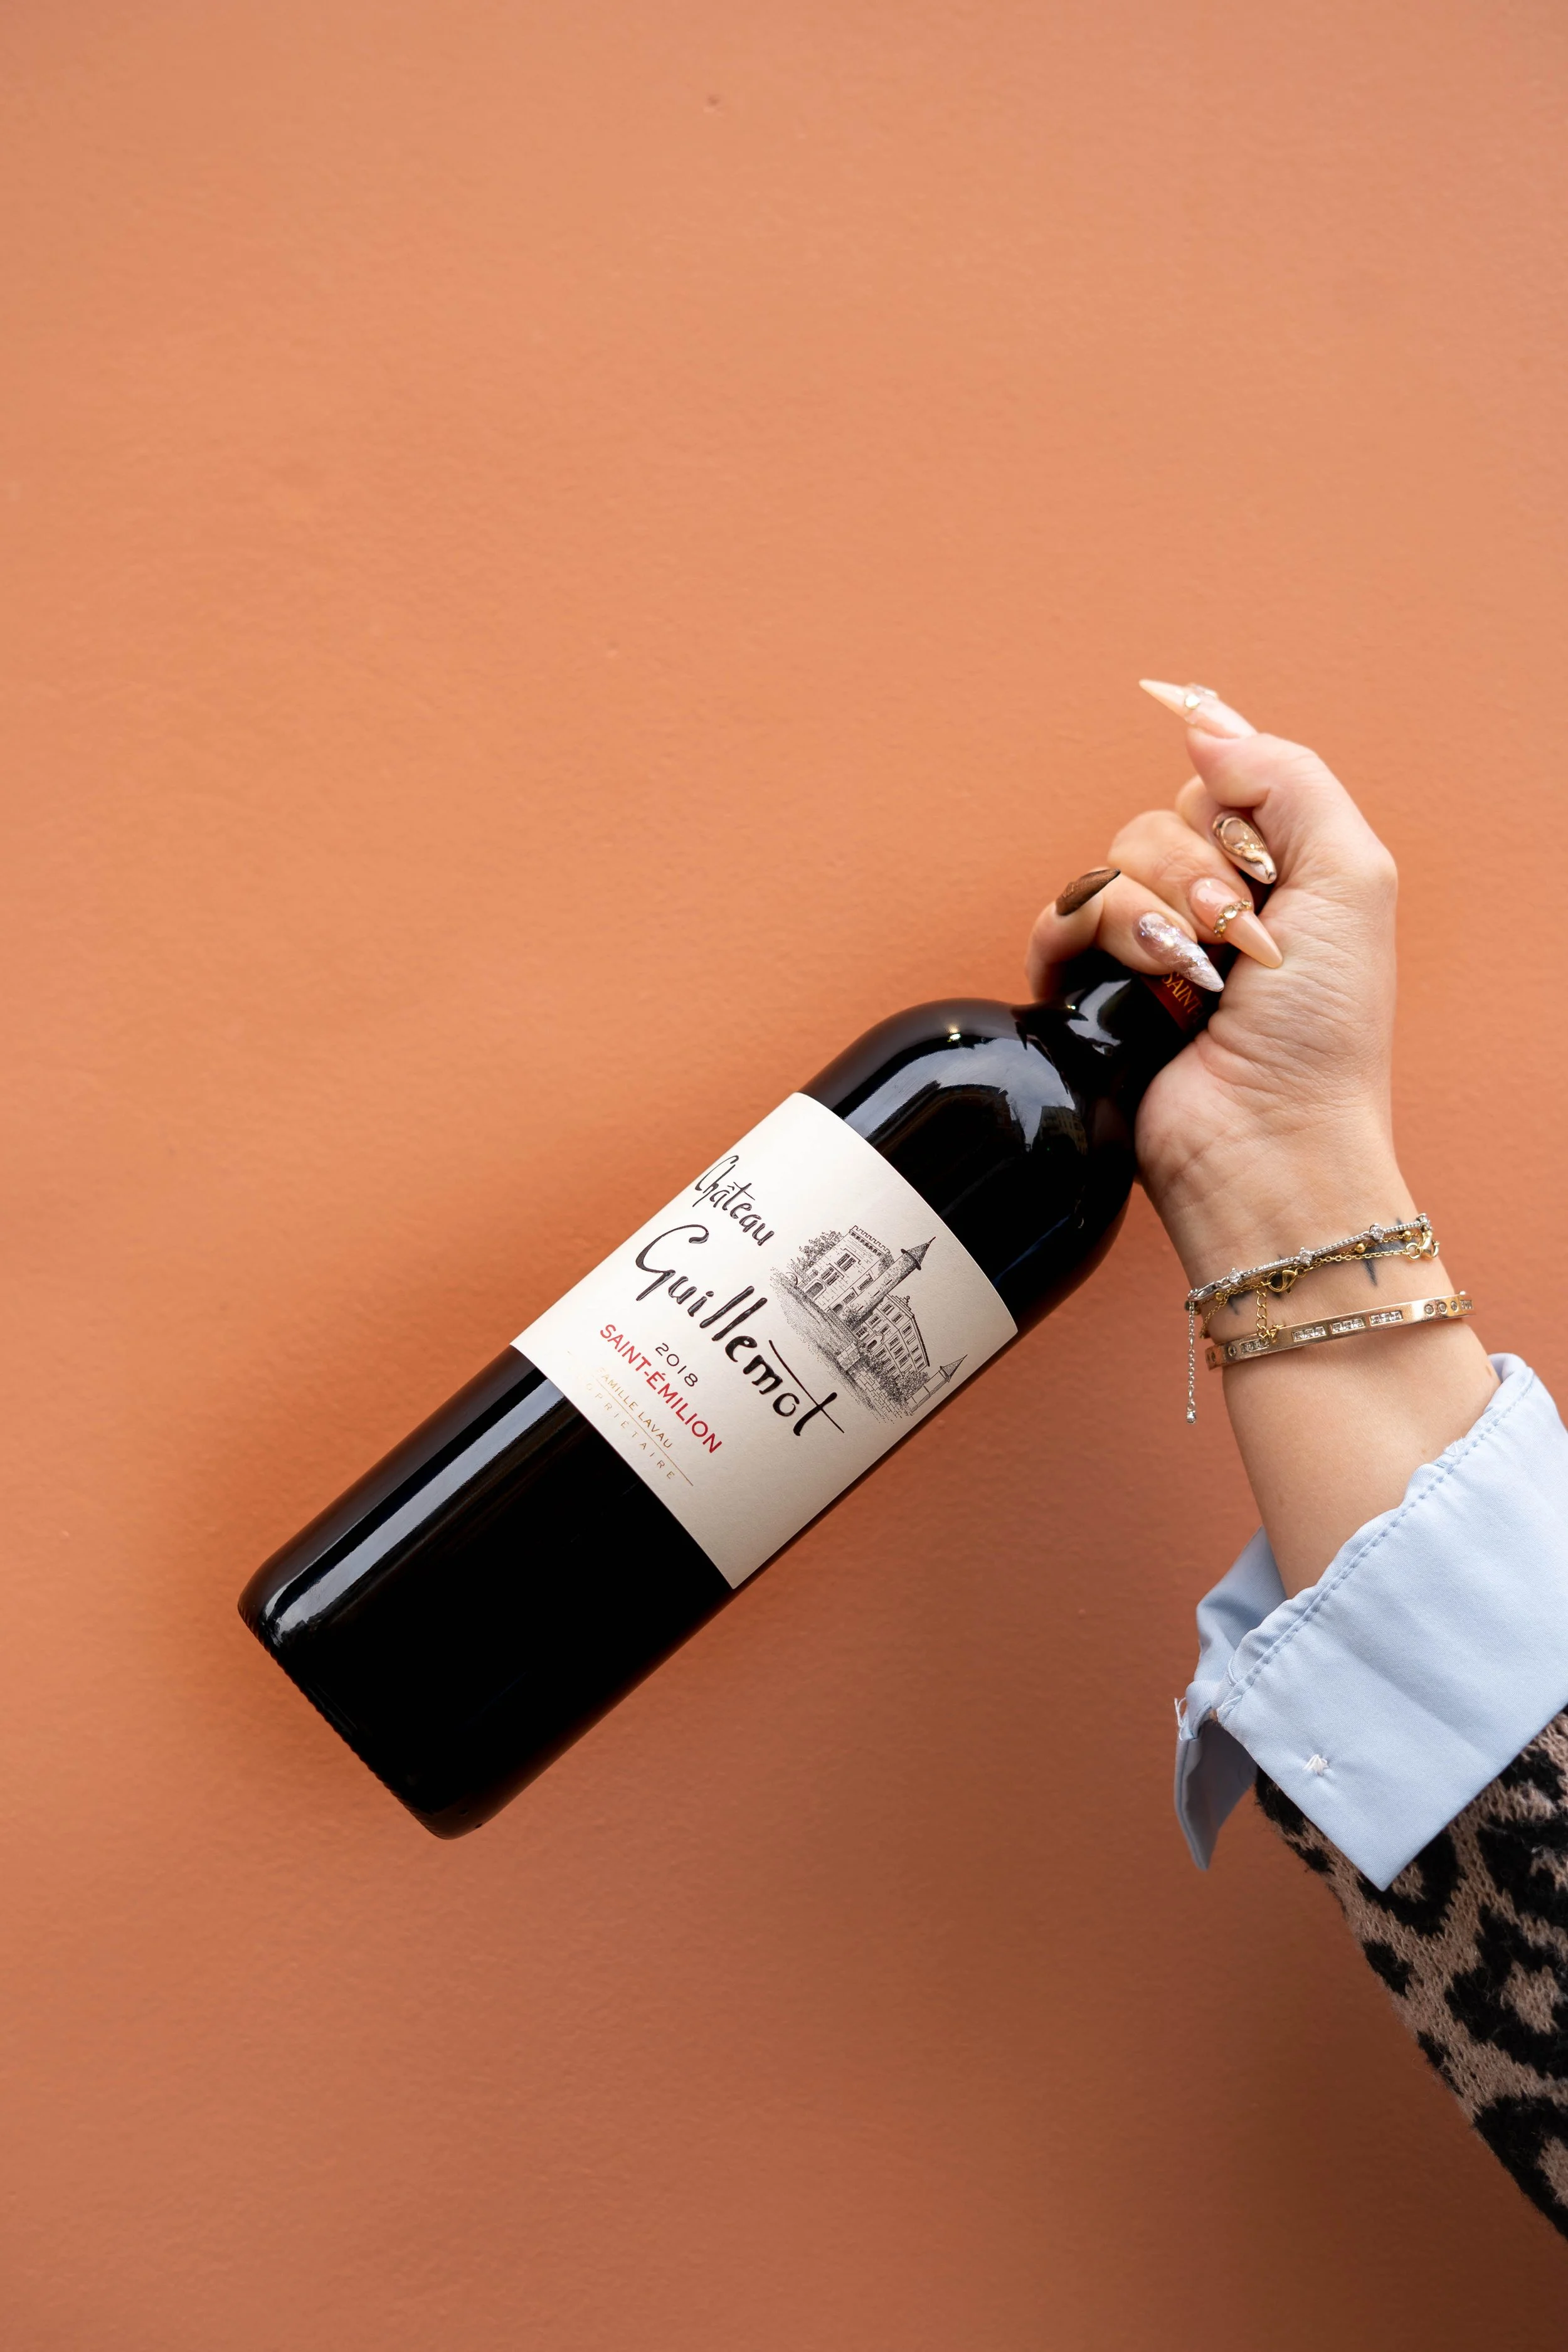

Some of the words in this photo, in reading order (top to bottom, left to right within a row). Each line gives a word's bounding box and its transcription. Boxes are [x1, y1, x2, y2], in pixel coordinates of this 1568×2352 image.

[693, 1155, 774, 1246] Château
[635, 1224, 844, 1436] Guillemot
[655, 1343, 698, 1387] 2018
[600, 1324, 723, 1453] SAINT-ÉMILION
[638, 1412, 673, 1448] LAVAU
